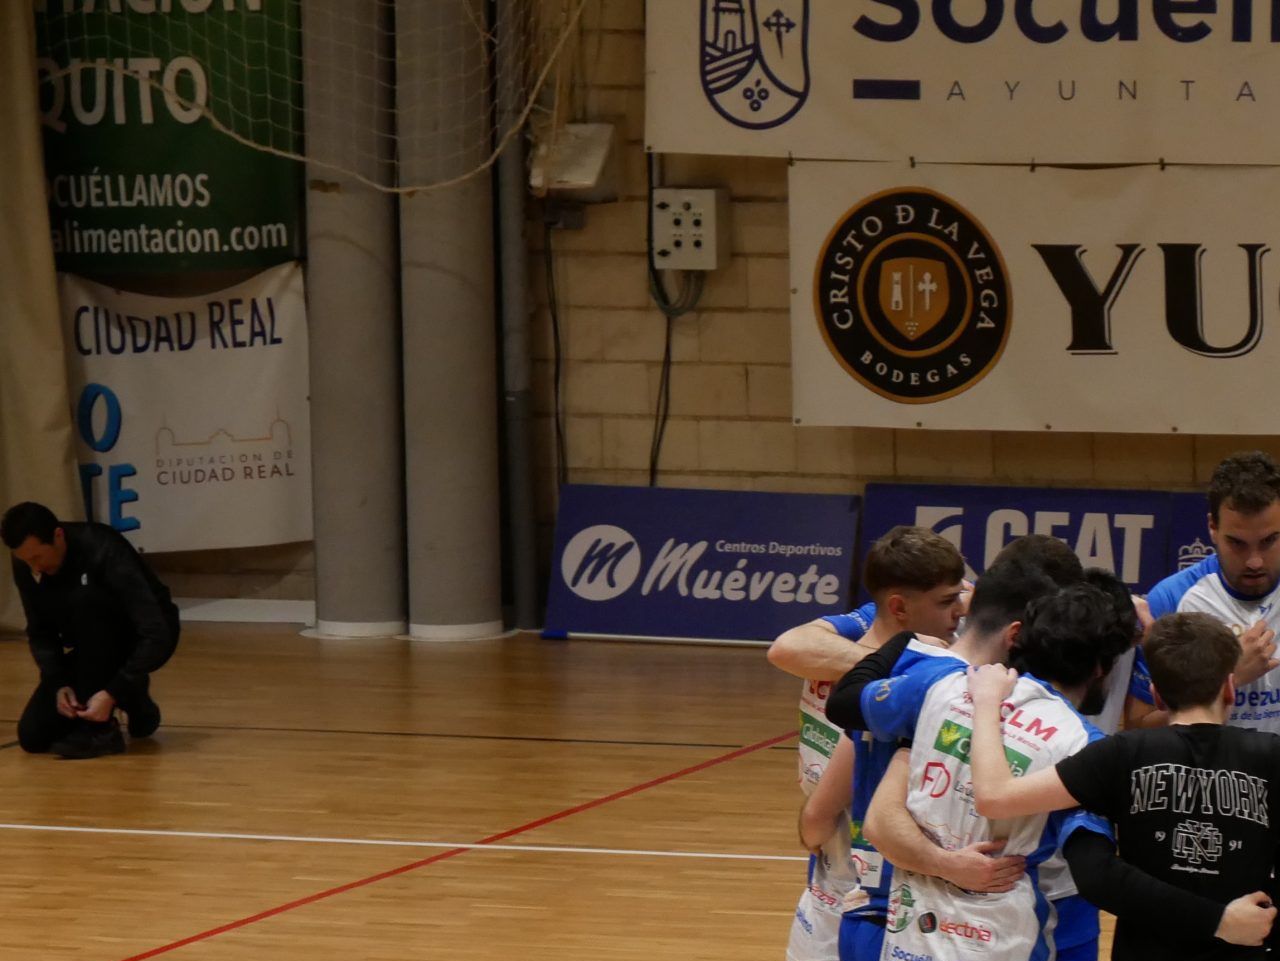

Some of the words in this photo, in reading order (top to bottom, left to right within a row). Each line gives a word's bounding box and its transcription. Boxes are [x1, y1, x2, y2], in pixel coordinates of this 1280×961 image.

[829, 216, 883, 330] CRISTO
[928, 208, 959, 241] LA
[966, 241, 998, 330] VEGA
[74, 305, 197, 357] CIUDAD
[207, 297, 283, 349] REAL
[860, 350, 972, 385] BODEGAS
[157, 467, 235, 485] CIUDAD
[243, 463, 294, 480] REAL
[641, 537, 840, 605] Muévete
[715, 539, 766, 554] Centros
[768, 541, 842, 558] Deportivos
